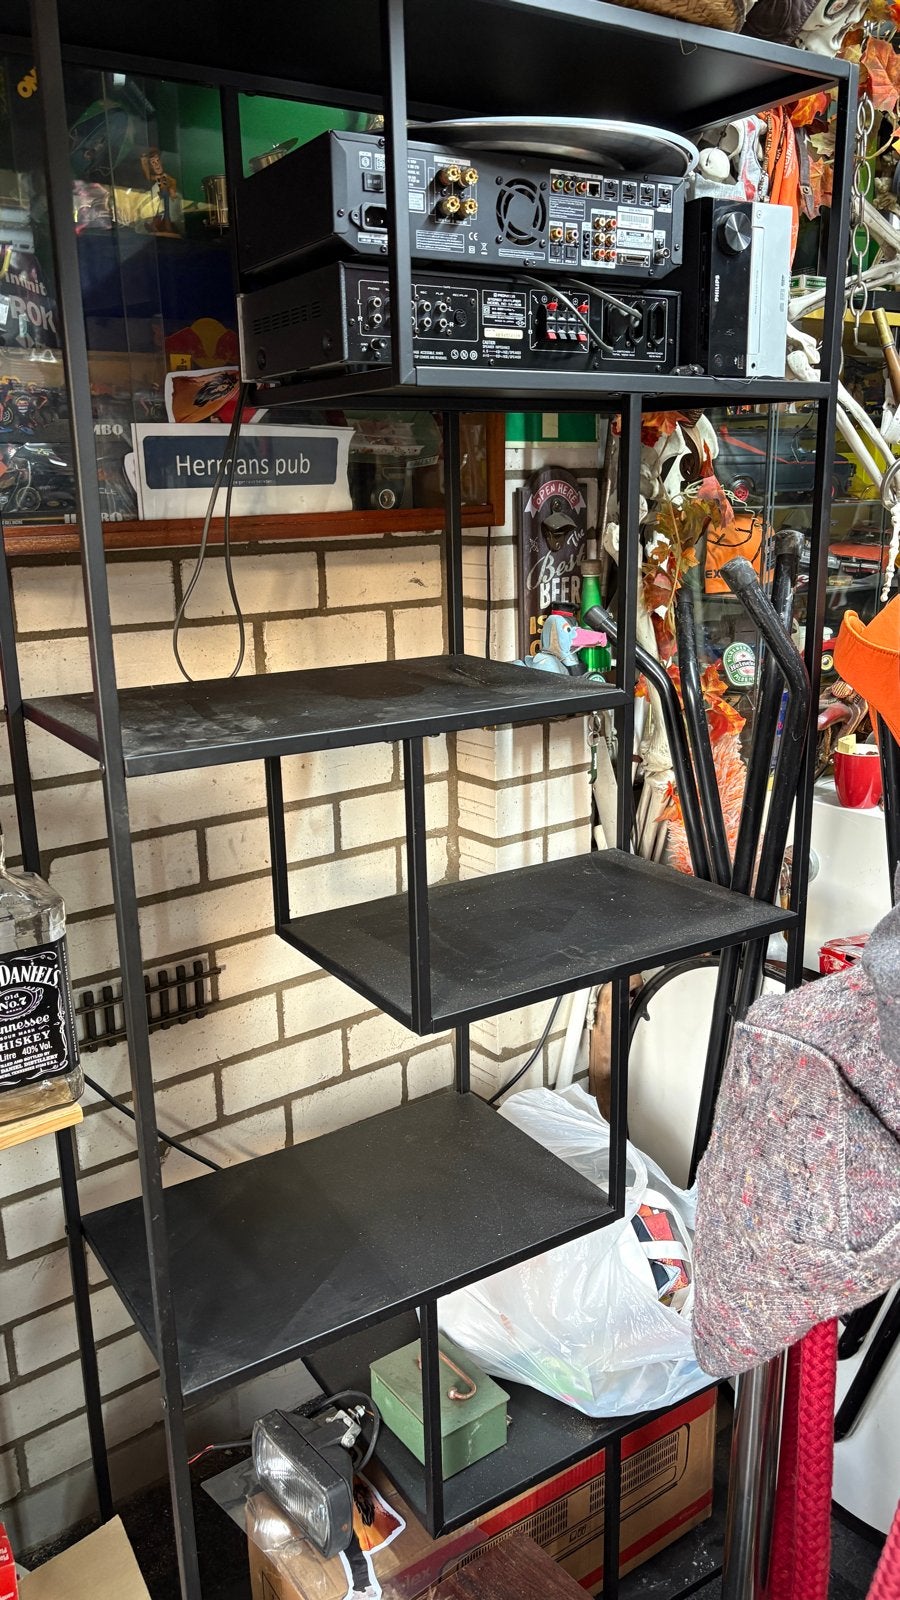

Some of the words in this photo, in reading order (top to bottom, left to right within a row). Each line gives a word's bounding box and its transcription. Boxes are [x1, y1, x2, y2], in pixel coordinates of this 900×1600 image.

[275, 452, 311, 477] pub
[536, 484, 556, 505] OPEN
[558, 483, 578, 504] HERE
[566, 529, 585, 547] The
[526, 543, 587, 591] Best
[539, 575, 581, 610] BEER
[21, 1044, 39, 1056] 40%
[39, 1040, 53, 1051] Vol.
